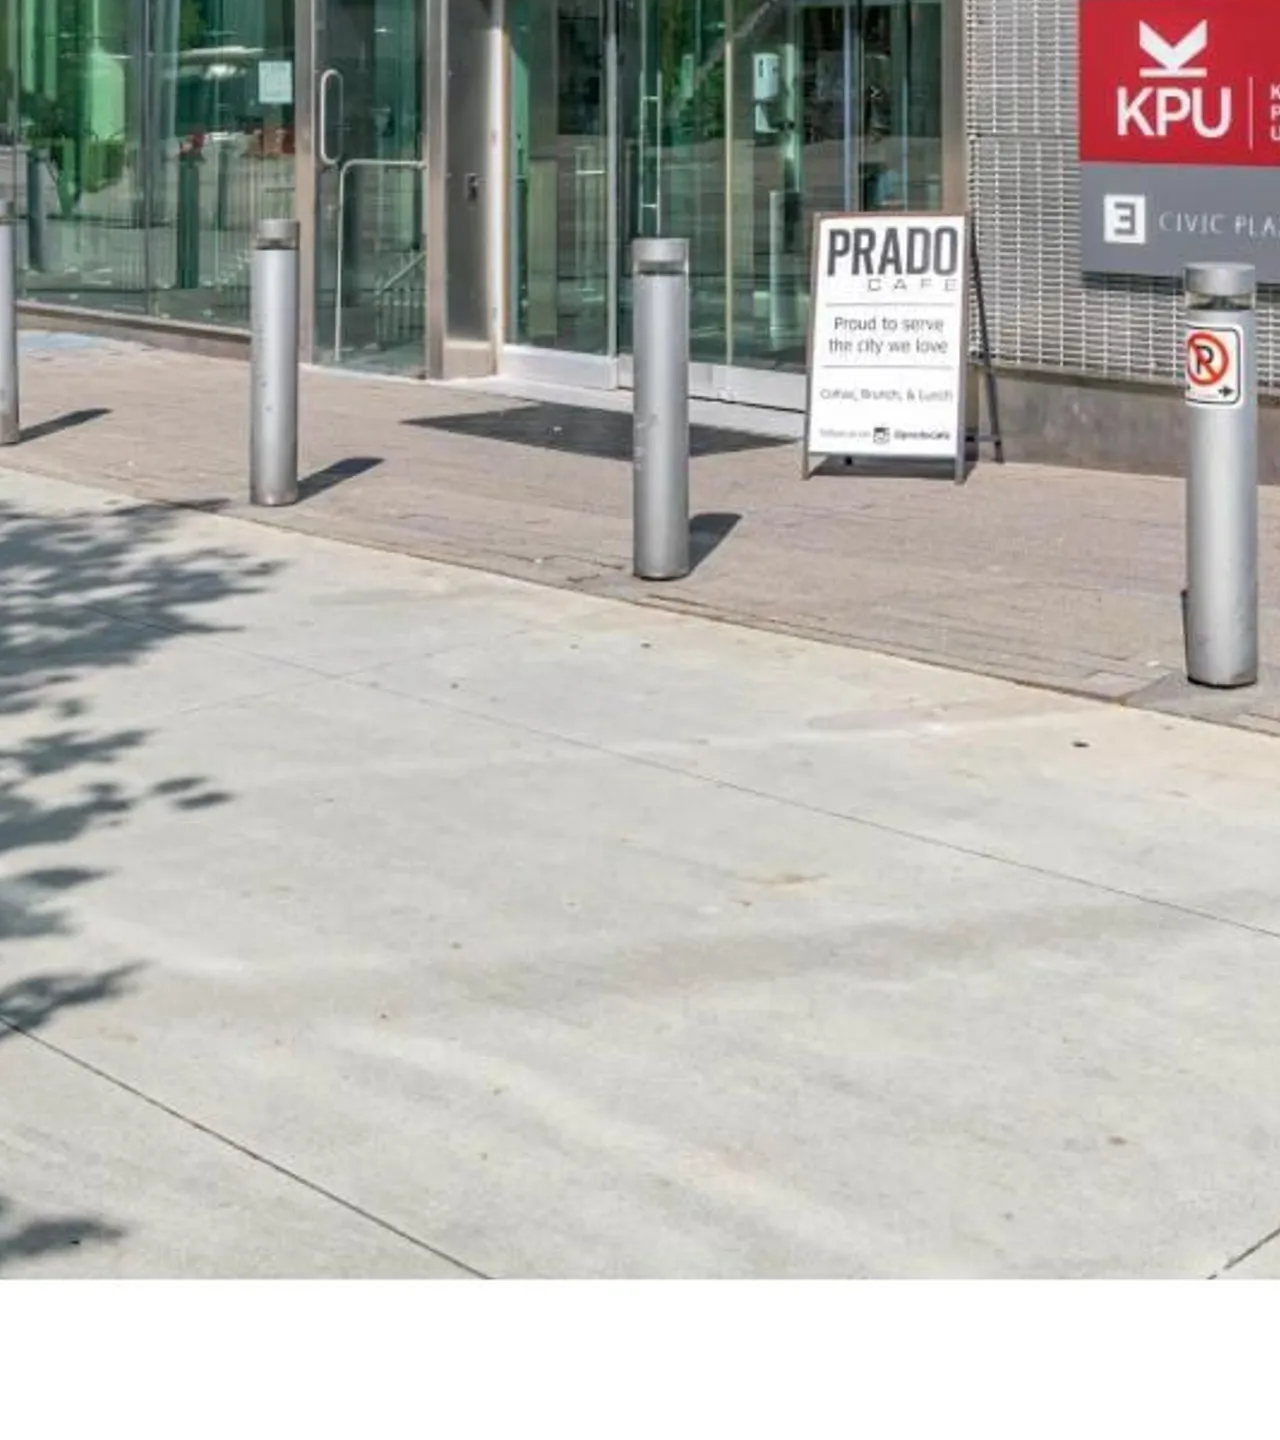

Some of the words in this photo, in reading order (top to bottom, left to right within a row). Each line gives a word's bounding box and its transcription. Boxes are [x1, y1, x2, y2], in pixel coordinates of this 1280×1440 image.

[1116, 86, 1232, 138] KPU
[1158, 212, 1225, 235] CIVIC
[827, 226, 958, 277] PRADO
[867, 278, 959, 292] CAFE
[834, 317, 877, 331] Proud
[882, 317, 898, 331] to
[901, 319, 945, 331] serve
[828, 338, 853, 353] the
[857, 338, 885, 356] city
[888, 341, 910, 353] we
[916, 338, 948, 354] love
